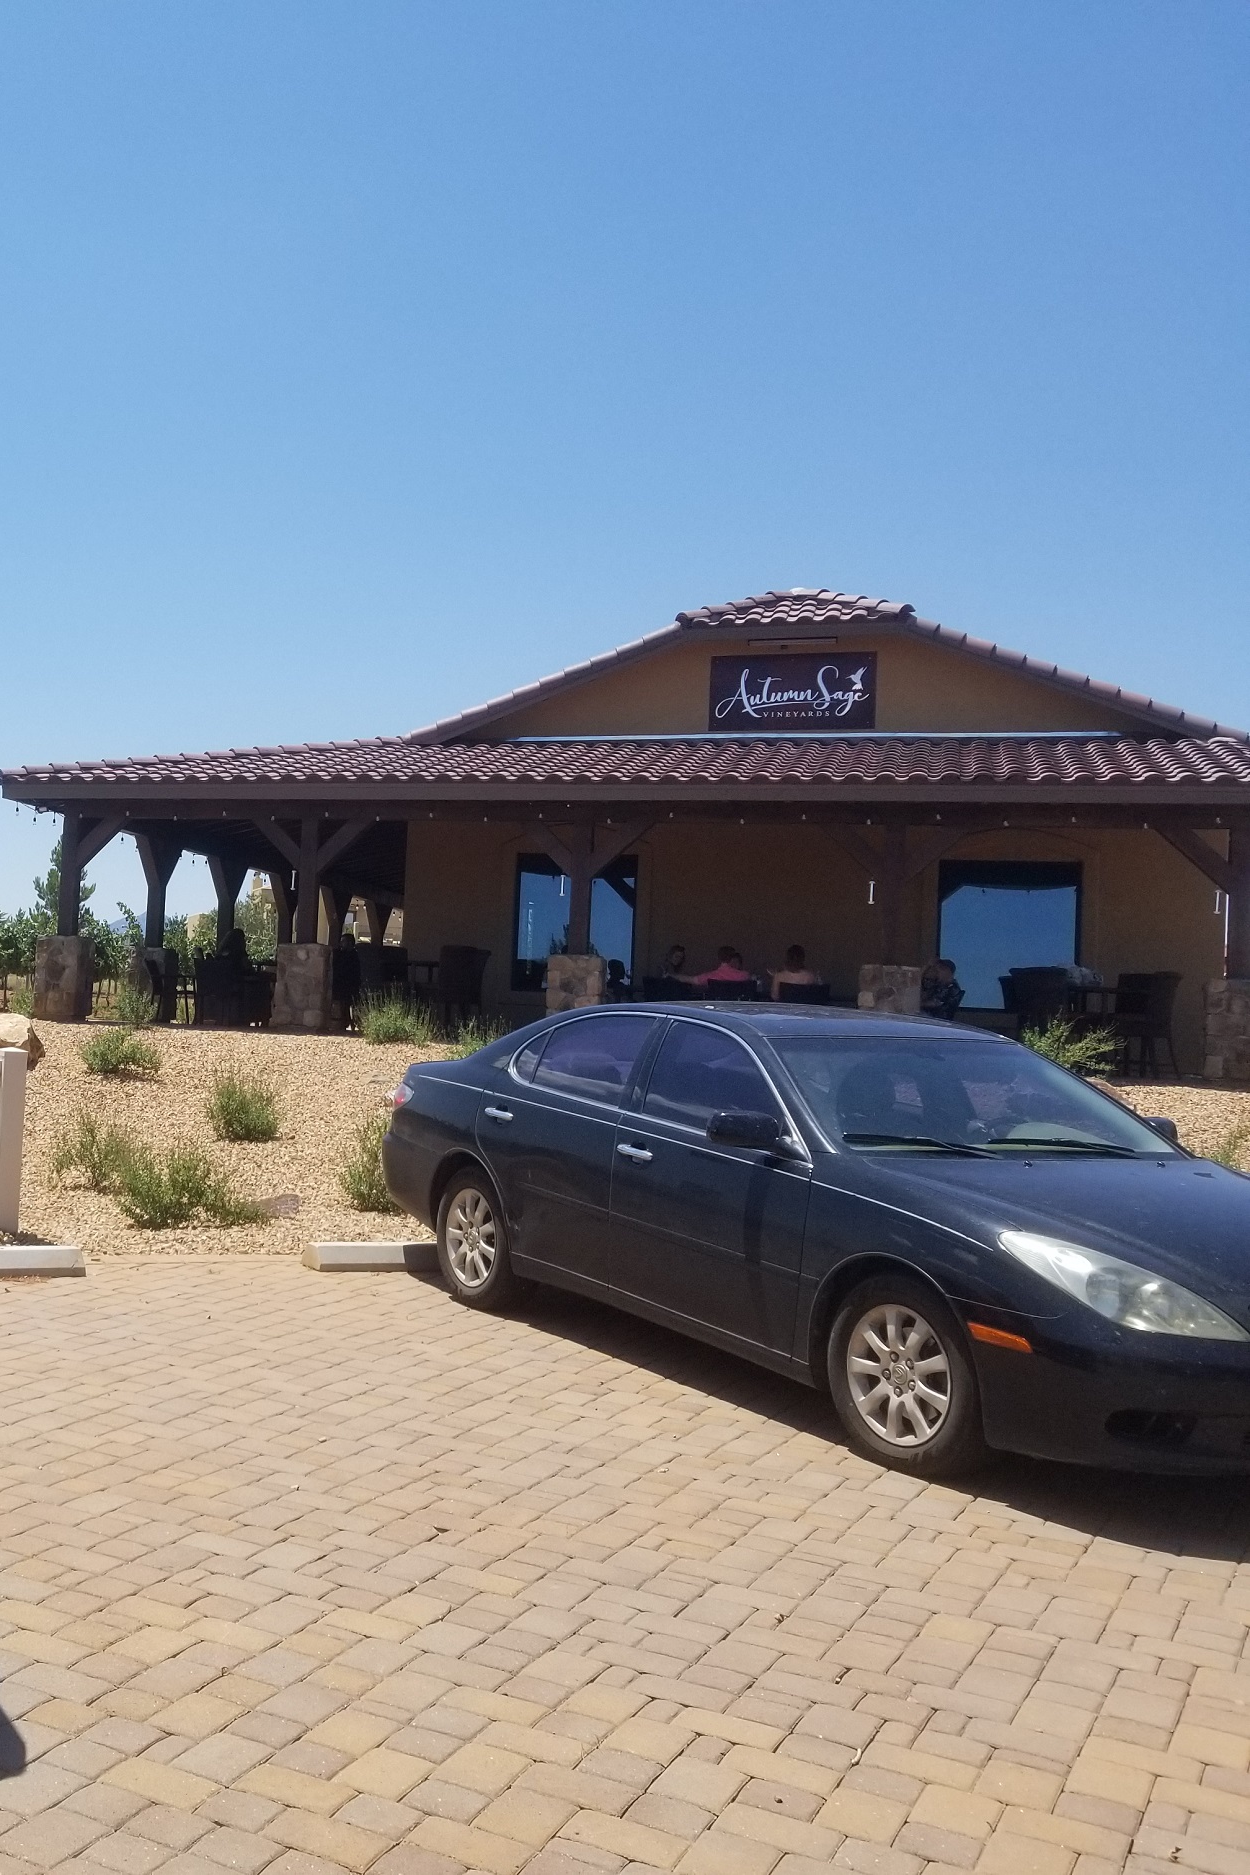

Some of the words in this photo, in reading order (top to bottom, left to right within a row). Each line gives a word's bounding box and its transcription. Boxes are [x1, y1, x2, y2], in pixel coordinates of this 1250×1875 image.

[715, 668, 819, 719] Autumn
[814, 665, 870, 717] Sage
[762, 710, 831, 718] VINEYARDS
